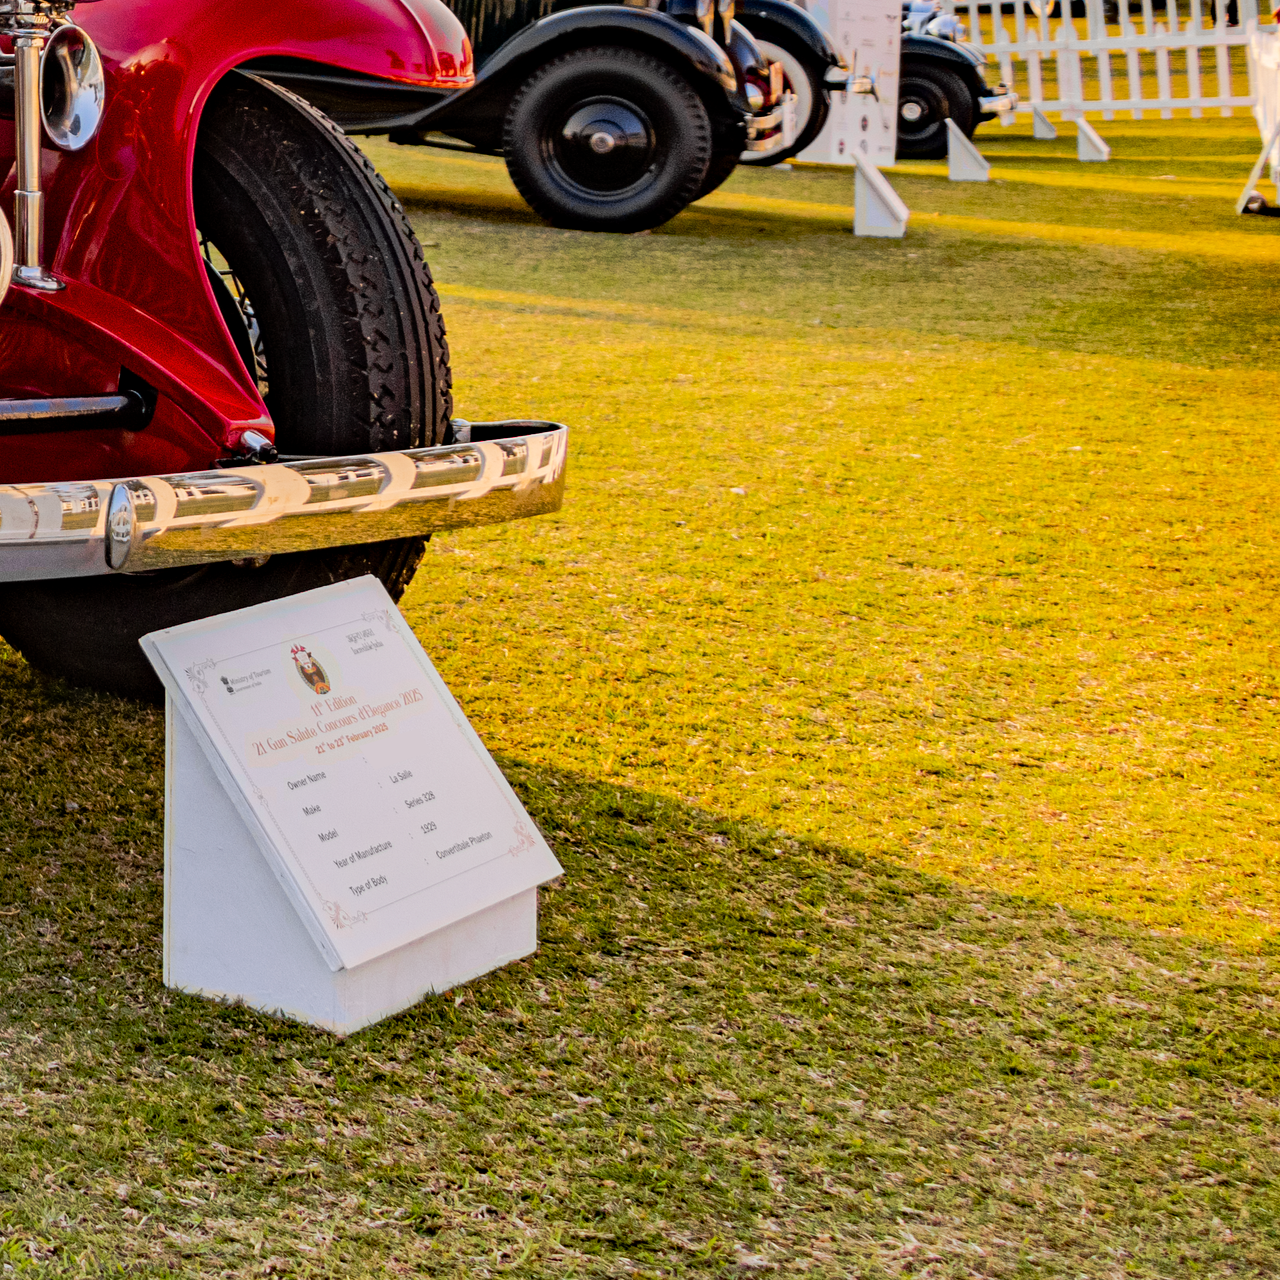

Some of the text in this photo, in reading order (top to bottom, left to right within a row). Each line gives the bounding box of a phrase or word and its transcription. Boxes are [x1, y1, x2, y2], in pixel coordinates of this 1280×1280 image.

[229, 676, 248, 685] Ministry
[253, 669, 271, 678] Tourism
[252, 688, 424, 756] 21 Gun Salute Concours d'Elegance 2025
[310, 695, 357, 717] 11th Edition
[327, 741, 335, 750] to
[345, 729, 374, 743] February
[372, 722, 389, 734] 2025
[287, 778, 308, 790] Owner
[306, 772, 326, 783] Name
[302, 805, 321, 816] Make
[389, 775, 399, 783] La
[397, 770, 413, 780] Salle
[318, 828, 339, 842] Model
[404, 797, 424, 809] Series
[422, 791, 436, 802] 328
[333, 858, 349, 869] Year
[354, 840, 392, 860] Manufacture
[420, 821, 437, 834] 1929
[349, 884, 365, 896] Type
[371, 874, 388, 887] Body
[436, 840, 471, 859] Convertibale
[468, 831, 493, 846] Phaeton
